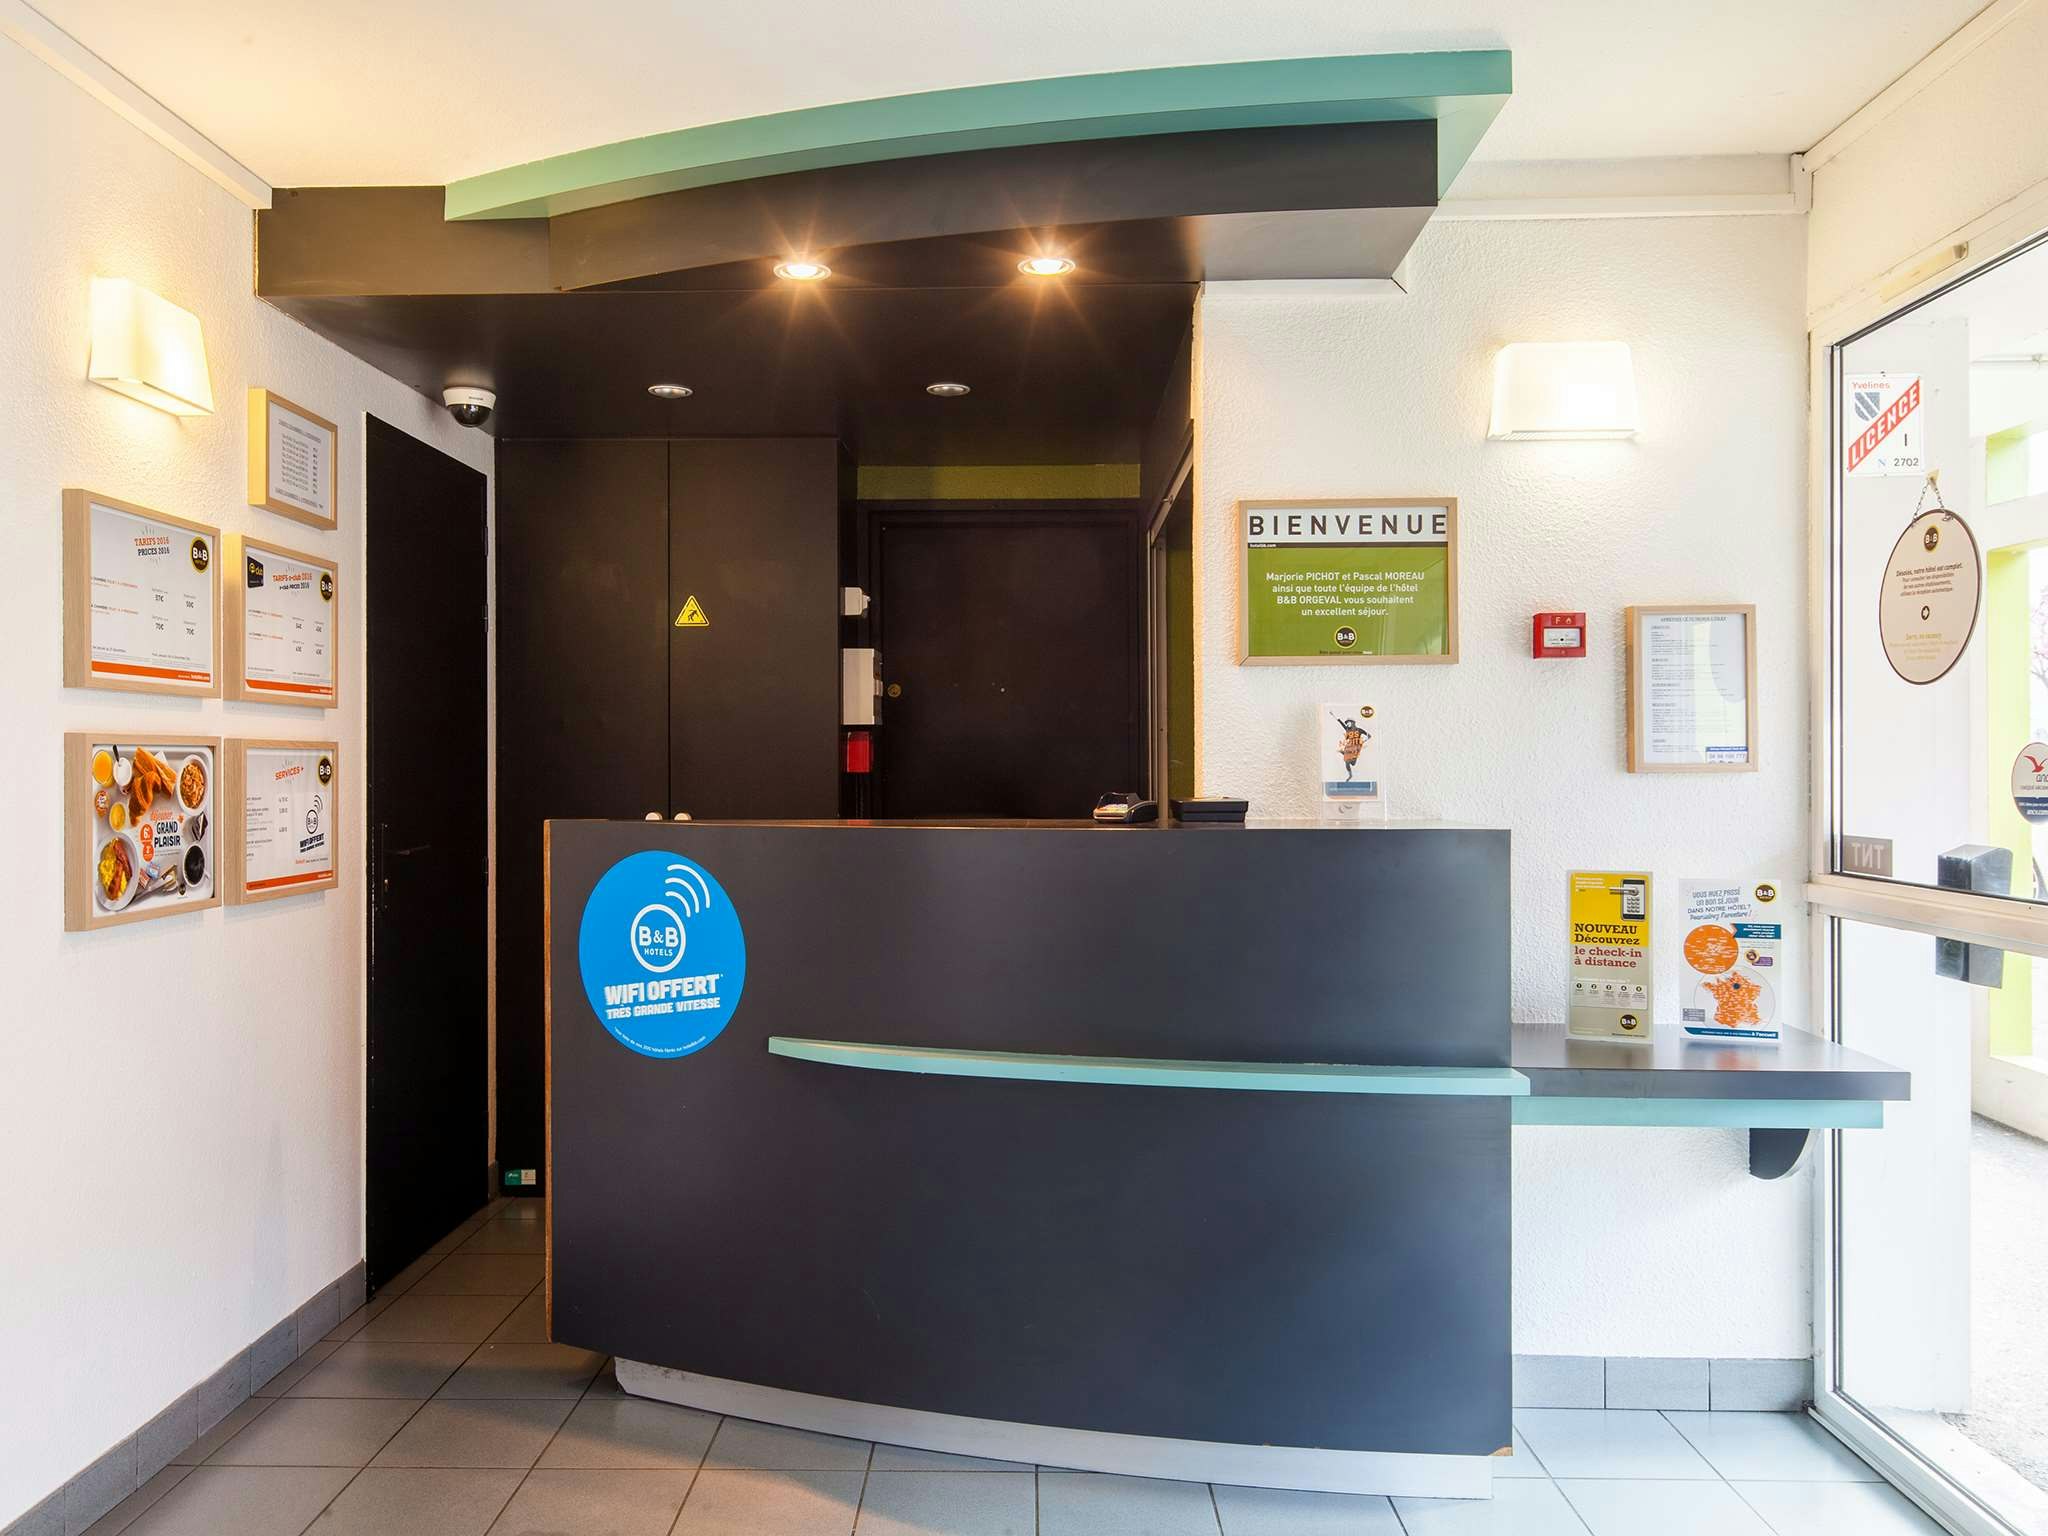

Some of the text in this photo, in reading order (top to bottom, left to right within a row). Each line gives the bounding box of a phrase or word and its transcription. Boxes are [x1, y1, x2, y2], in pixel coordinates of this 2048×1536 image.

[1850, 385, 1918, 466] LICENCE
[1894, 458, 1919, 466] 2702
[1249, 514, 1446, 536] BIENVENUE
[134, 536, 170, 546] TARIFS 2016
[1925, 532, 1938, 544] B&B
[138, 548, 158, 556] PRICES
[192, 547, 208, 561] B&B
[1266, 572, 1304, 583] Marjorie
[1306, 572, 1340, 580] PICHOT
[1353, 572, 1382, 580] Pascal
[1385, 572, 1424, 580] MOREAU
[321, 581, 332, 592] B&B
[1272, 584, 1294, 592] ainsi
[1295, 586, 1312, 594] que
[1340, 584, 1374, 594] l'équipe
[1376, 584, 1388, 592] de
[1390, 584, 1418, 592] l'hôtel
[1276, 596, 1296, 604] B&B
[1299, 596, 1342, 604] ORGEVAL
[1366, 596, 1414, 604] souhaitent
[1314, 607, 1356, 616] excellent
[1358, 607, 1388, 618] séjour.
[275, 766, 300, 780] SERVICES
[320, 766, 331, 775] B&B
[156, 821, 178, 834] GRAND
[154, 836, 180, 848] PLAISIR
[1574, 923, 1637, 935] NOUVEAU
[638, 926, 679, 948] B&B
[1574, 934, 1640, 945] Découvrez
[644, 948, 673, 957] HOTELS
[1574, 946, 1642, 958] le check-in
[1574, 956, 1636, 968] à distance
[604, 982, 645, 1006] WIFI
[633, 1002, 674, 1017] GRANDE
[676, 997, 720, 1012] VITESSE
